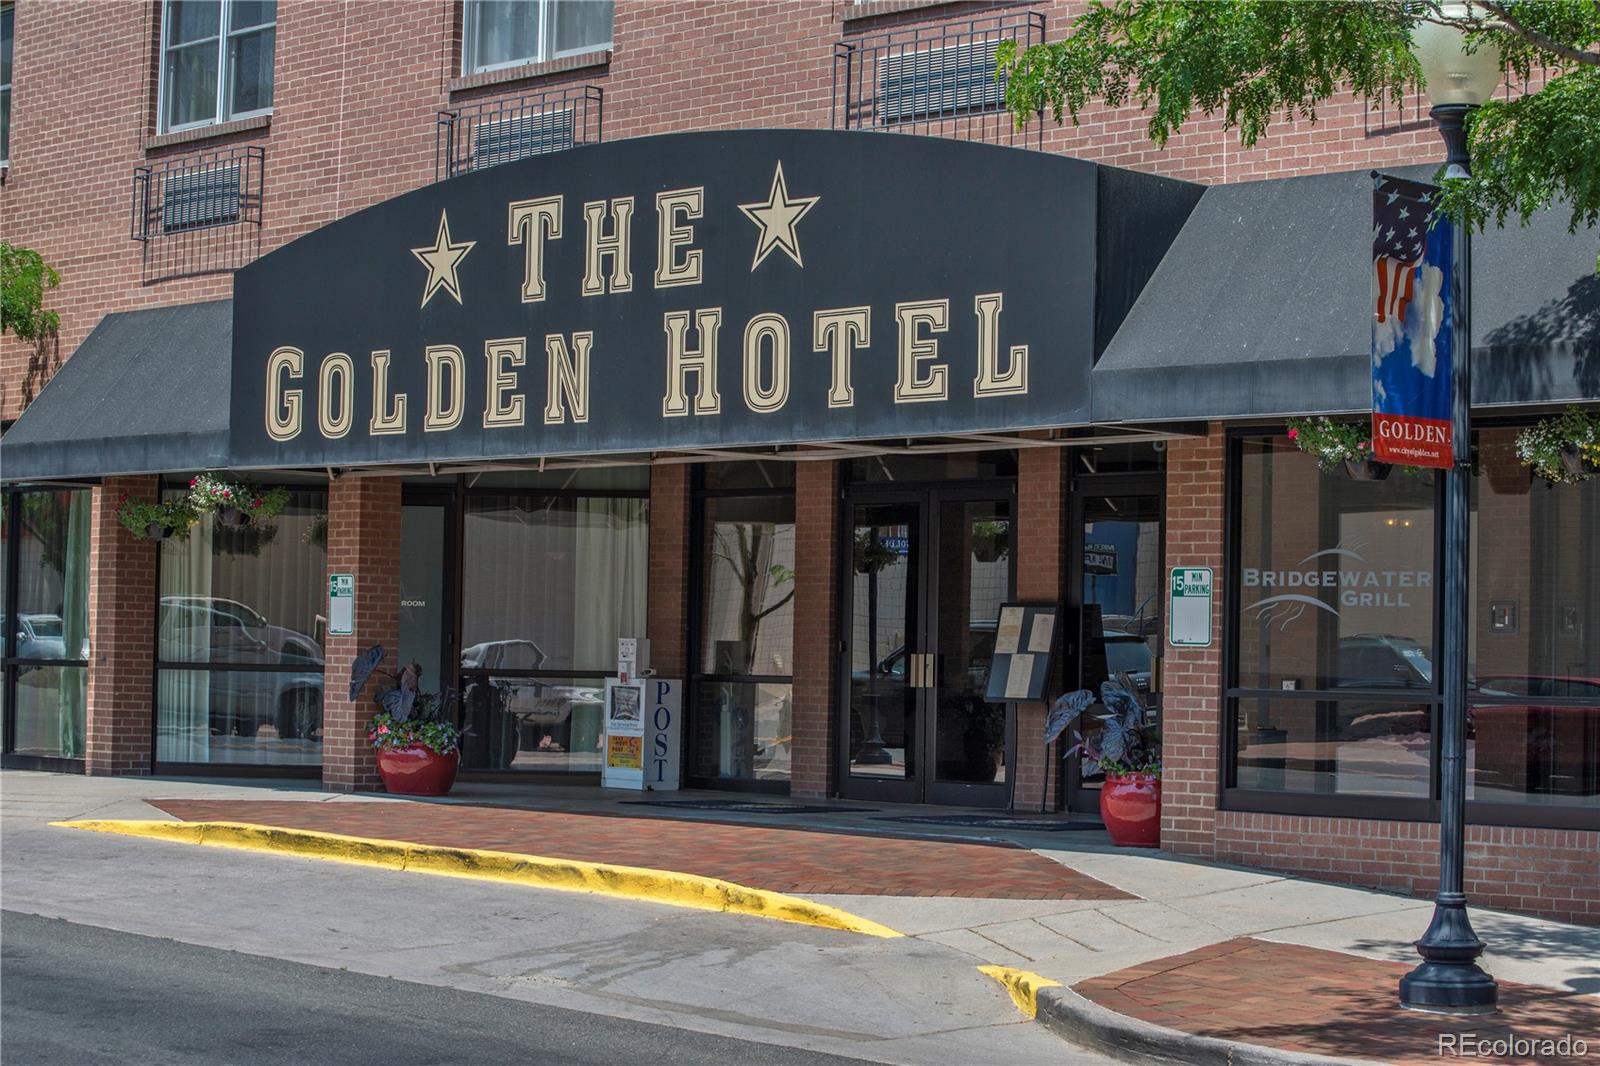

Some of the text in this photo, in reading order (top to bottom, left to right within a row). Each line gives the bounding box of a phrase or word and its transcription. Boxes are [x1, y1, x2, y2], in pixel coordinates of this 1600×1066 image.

[508, 186, 705, 304] THE
[265, 292, 1029, 442] GOLDEN HOTEL
[1172, 572, 1203, 591] 15 MIN
[1243, 568, 1432, 587] BRIDGEWATER
[1184, 584, 1210, 594] PARKING
[1340, 590, 1411, 607] GRILL
[401, 600, 426, 608] ROOM
[653, 681, 671, 782] POST
